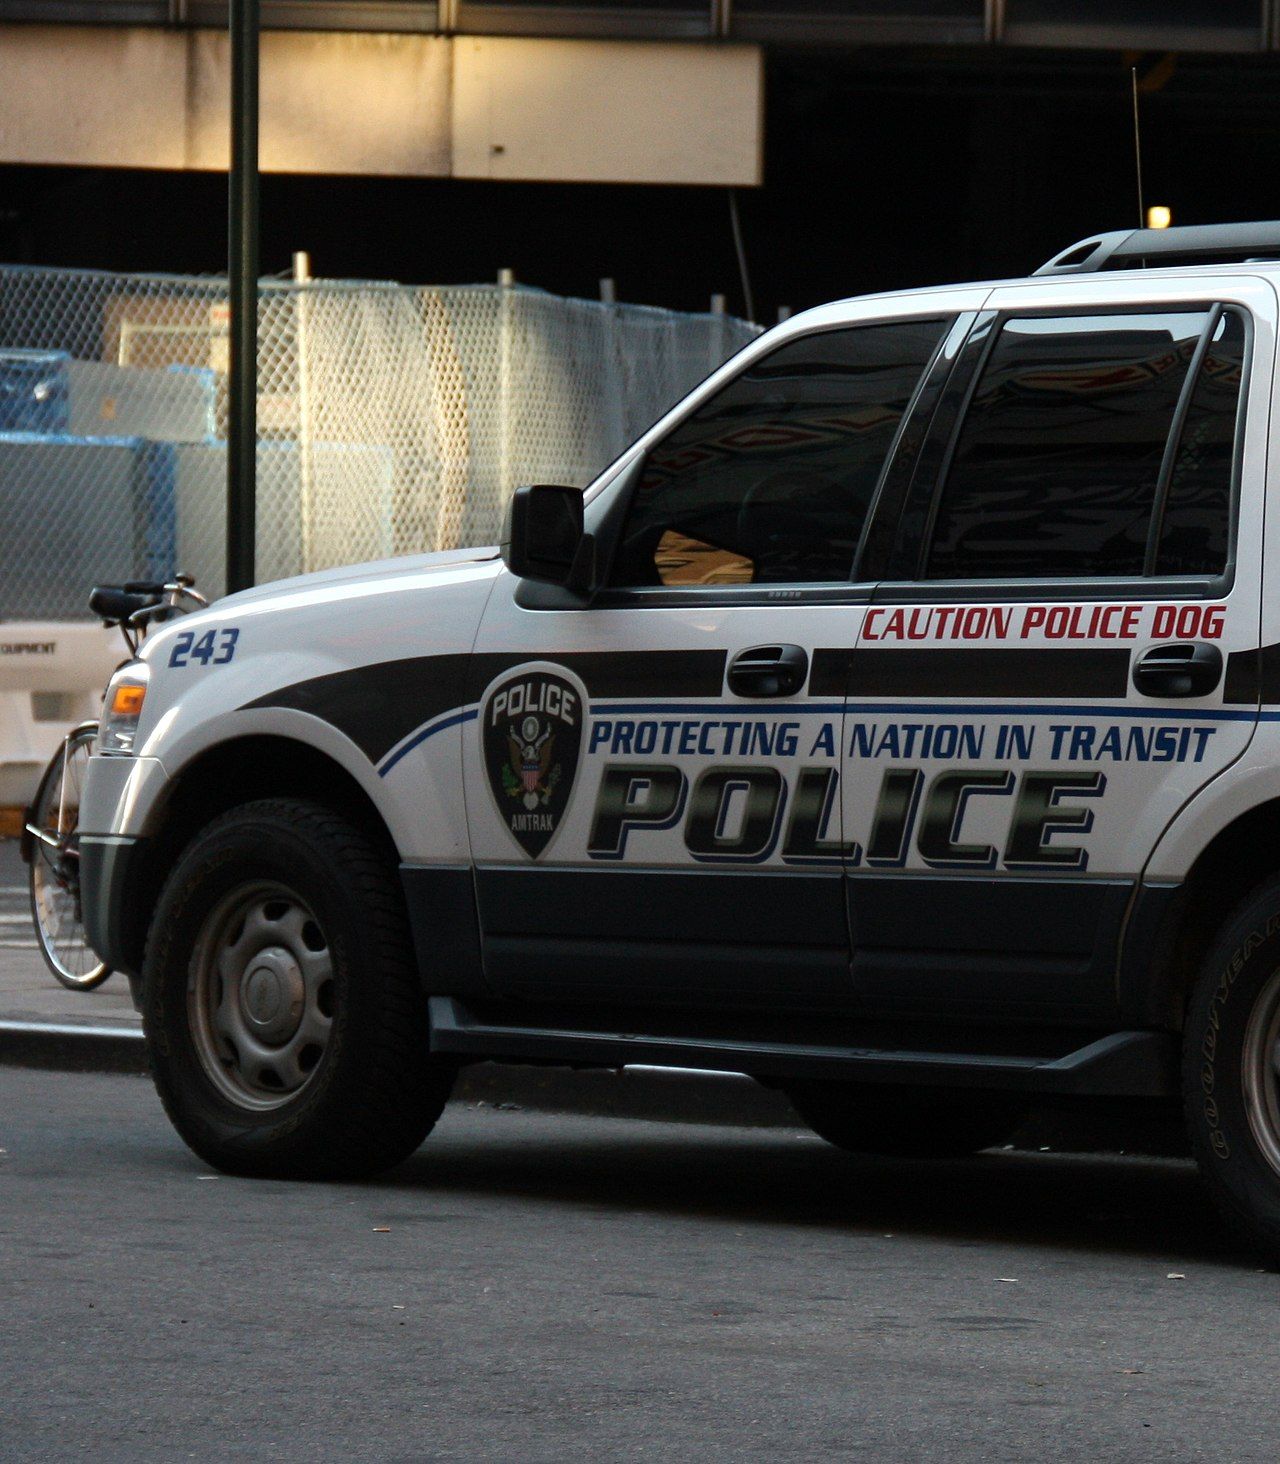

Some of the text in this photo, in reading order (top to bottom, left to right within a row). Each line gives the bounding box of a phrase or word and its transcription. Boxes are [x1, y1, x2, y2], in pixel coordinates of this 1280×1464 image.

[864, 605, 1227, 640] CAUTION POLICE DOG
[0, 642, 56, 655] QUIPMENT
[168, 628, 240, 668] 243
[491, 682, 575, 727] POLICE
[588, 721, 1217, 763] PROTECTING A NATION IN TRANSIT
[511, 814, 554, 831] AMTRAK
[587, 764, 1107, 871] POLICE
